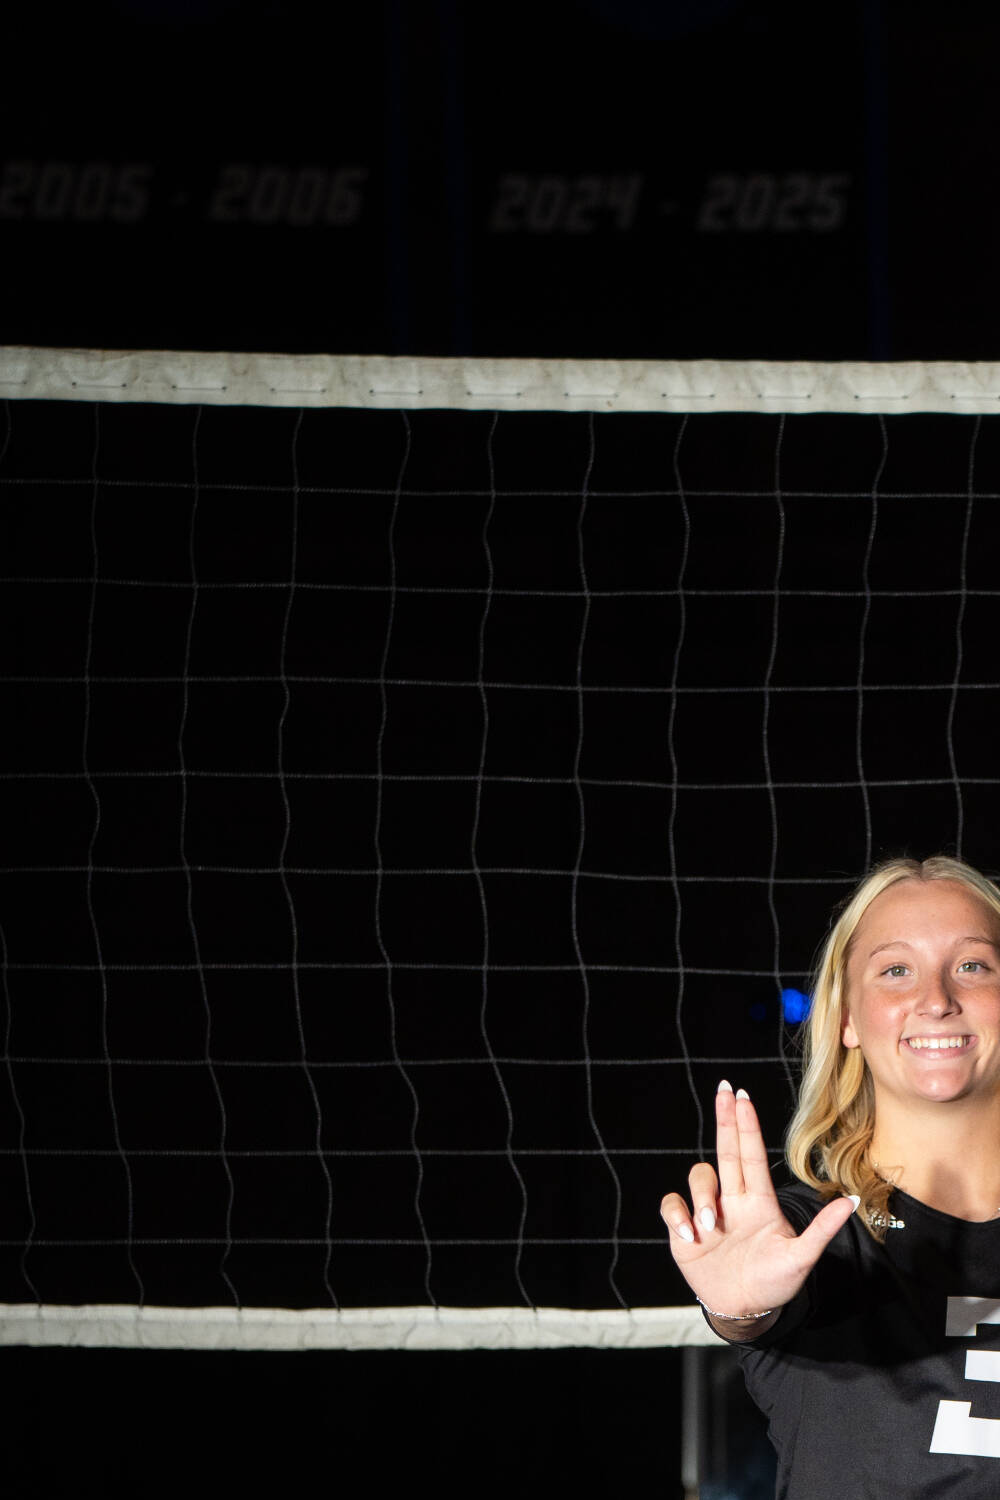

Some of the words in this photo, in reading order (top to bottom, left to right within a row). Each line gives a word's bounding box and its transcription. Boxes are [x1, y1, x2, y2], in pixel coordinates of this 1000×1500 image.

[0, 161, 153, 223] 2005
[203, 162, 369, 226] 2006
[489, 171, 645, 234] 2024
[696, 171, 853, 234] 2025
